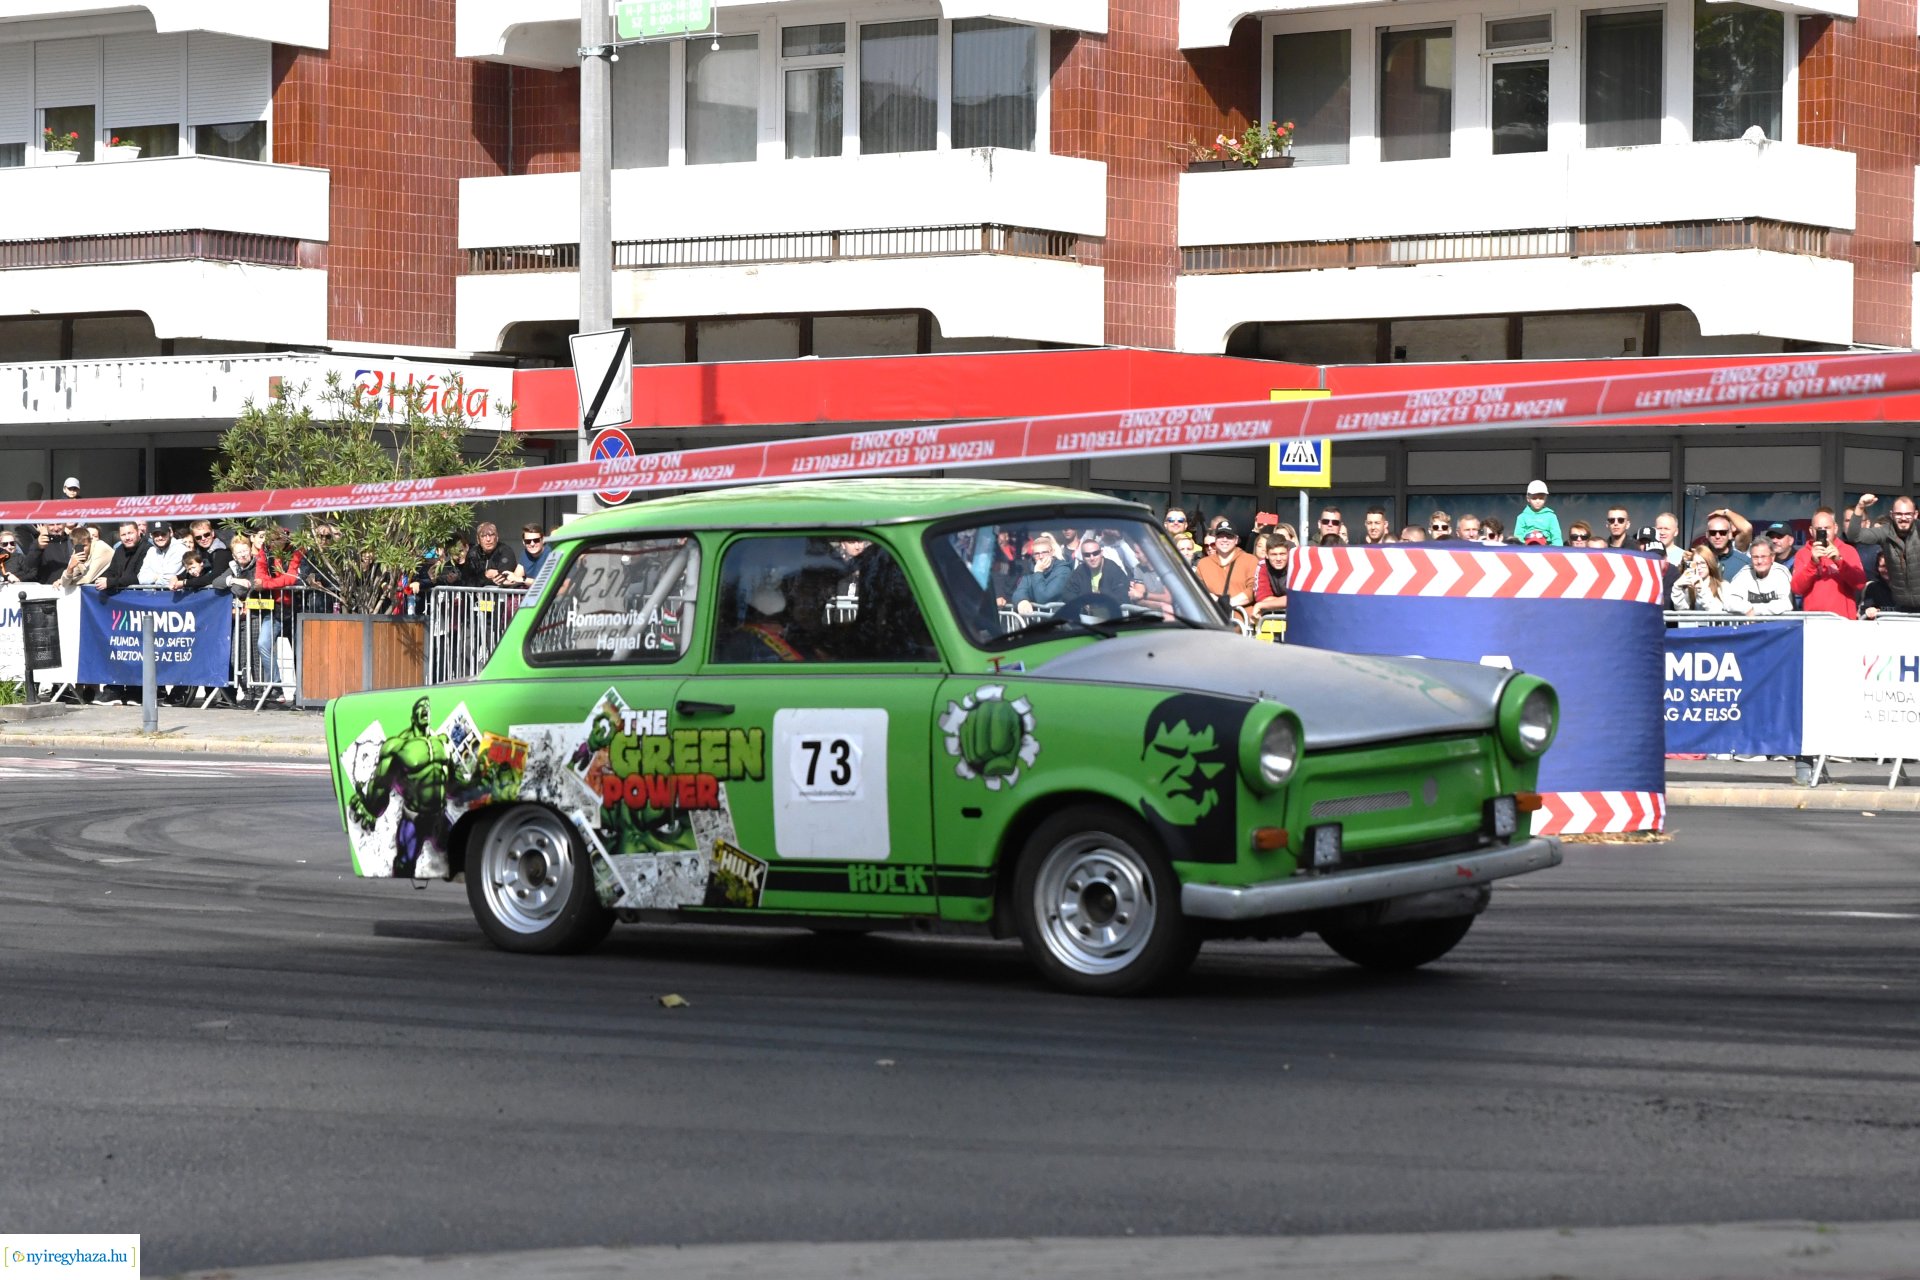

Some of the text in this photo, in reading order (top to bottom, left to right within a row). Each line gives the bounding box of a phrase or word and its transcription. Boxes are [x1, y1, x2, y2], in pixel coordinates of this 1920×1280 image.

[1709, 362, 1818, 385] NO GO ZONE!
[388, 371, 489, 417] Háda
[1404, 387, 1506, 408] NO GO ZONE!
[1118, 408, 1214, 428] NO GO ZONE!
[851, 429, 939, 450] NO GO ZONE!
[598, 454, 682, 474] NO GO ZONE!
[395, 480, 414, 490] GO
[416, 479, 436, 489] NO
[130, 611, 195, 632] HMDA
[566, 609, 661, 627] Romanovits A.
[110, 636, 139, 647] HUMDA
[167, 637, 195, 647] SAFETY
[596, 633, 641, 652] Hajnal
[645, 634, 659, 649] G.
[110, 652, 116, 661] A
[117, 650, 159, 661] BIZTONG
[161, 652, 173, 661] AZ
[1665, 653, 1743, 681] MDA
[1664, 688, 1742, 702] AD SAFETY
[1864, 691, 1916, 704] HUMDA
[621, 710, 667, 736] THE
[1682, 708, 1702, 722] AZ
[1878, 709, 1920, 723] BIZTO
[609, 727, 765, 781] GREEN
[801, 739, 852, 786] 73
[602, 773, 720, 810] POWER
[721, 850, 765, 889] HULK
[847, 864, 928, 894] HULK
